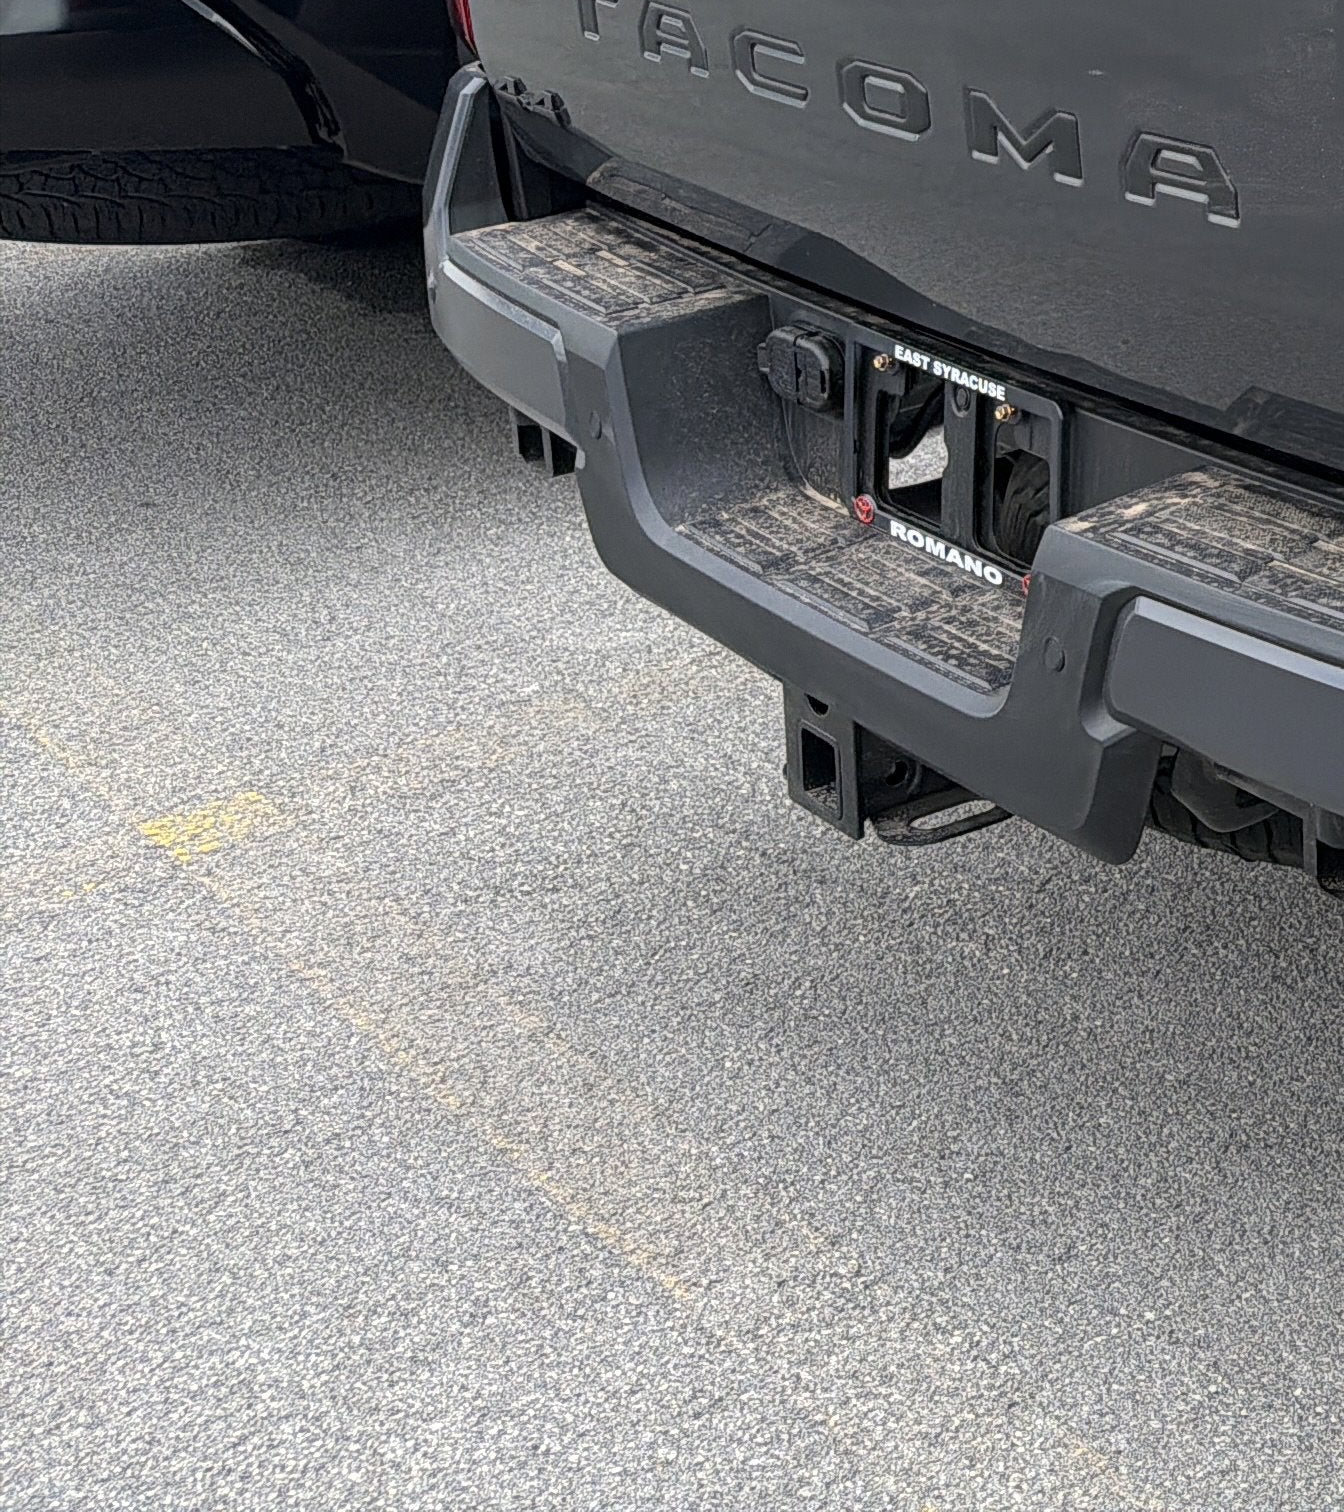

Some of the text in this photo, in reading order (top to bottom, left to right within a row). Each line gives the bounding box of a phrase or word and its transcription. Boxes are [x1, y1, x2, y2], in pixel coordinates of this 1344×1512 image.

[894, 345, 1006, 402] EAST SYRACUSE
[889, 519, 1003, 586] ROMANO
